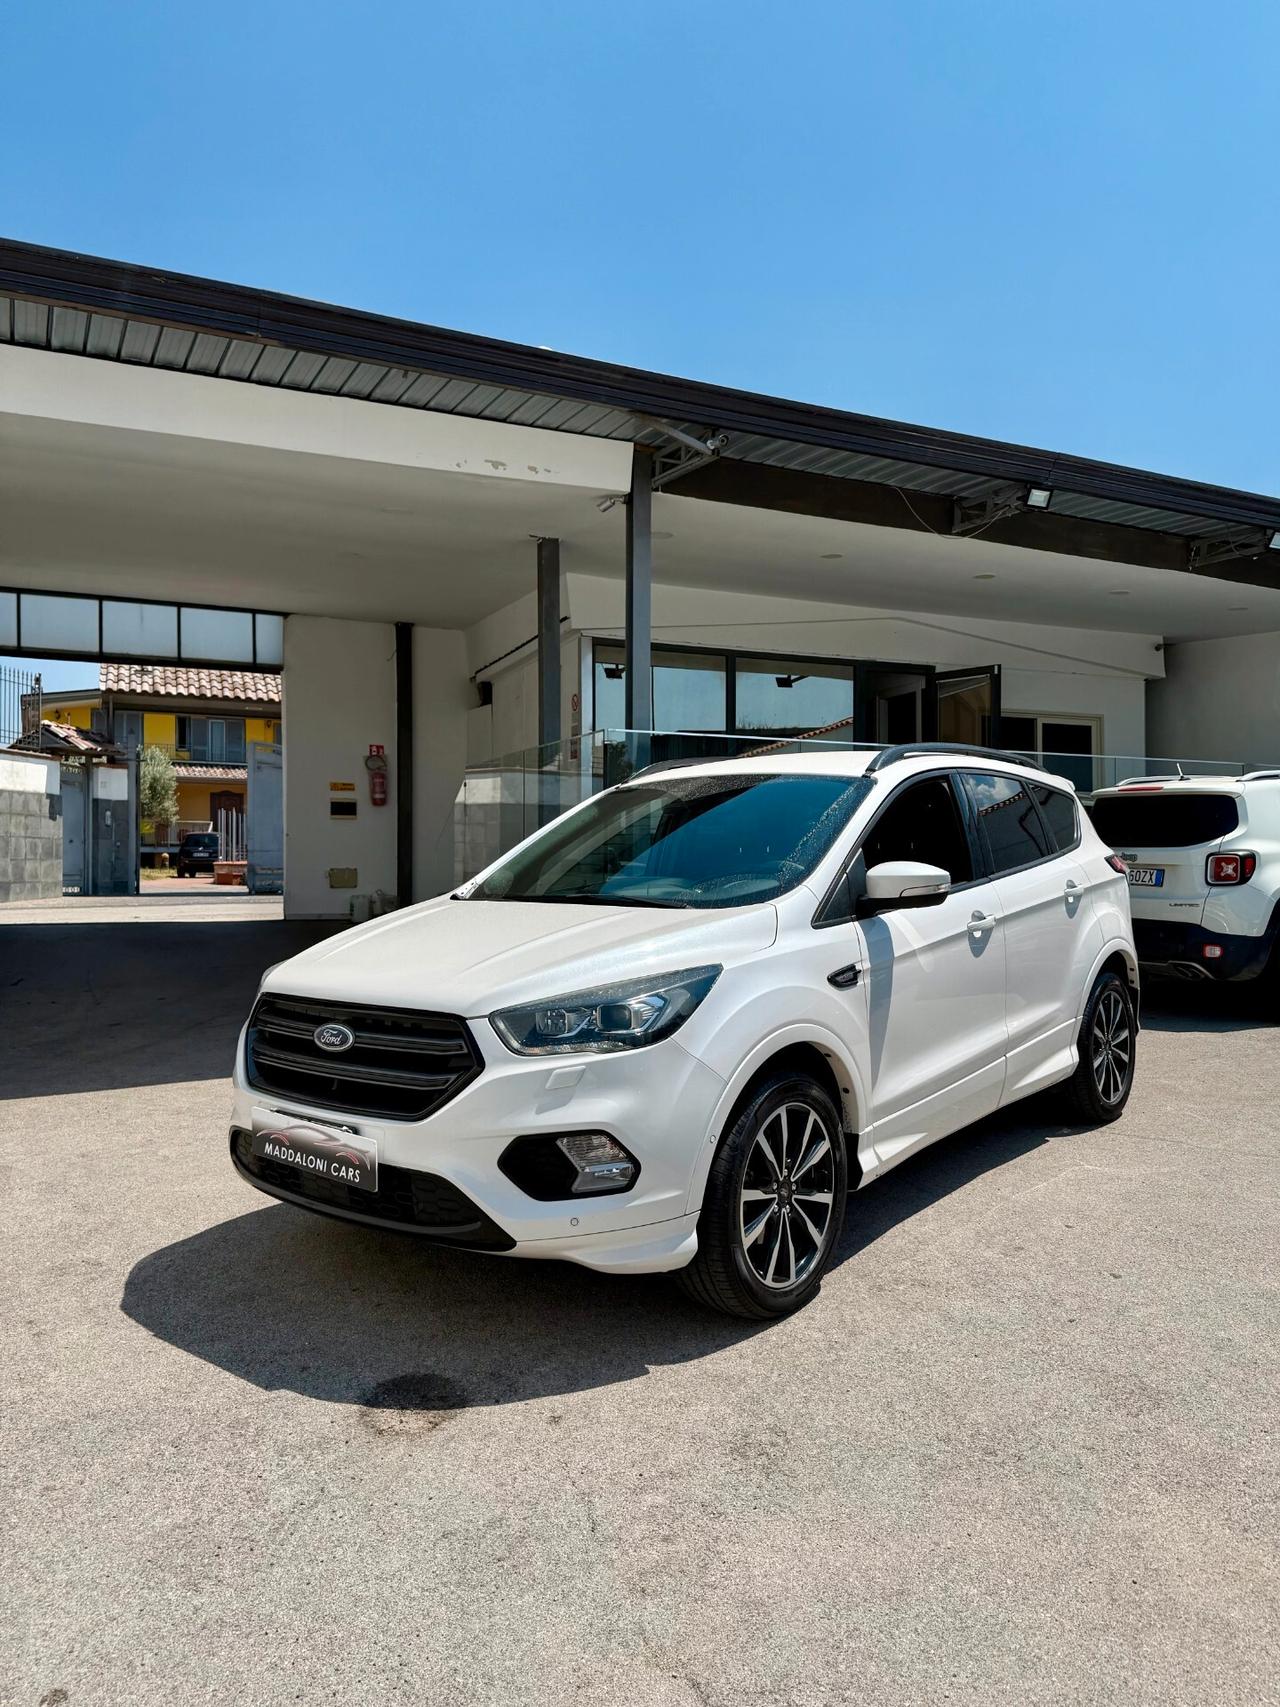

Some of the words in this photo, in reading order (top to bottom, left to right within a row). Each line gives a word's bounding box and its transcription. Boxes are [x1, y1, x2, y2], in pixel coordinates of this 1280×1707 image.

[320, 1029, 343, 1045] Ford
[264, 1142, 328, 1173] MADDALONI
[330, 1163, 361, 1183] CARS
